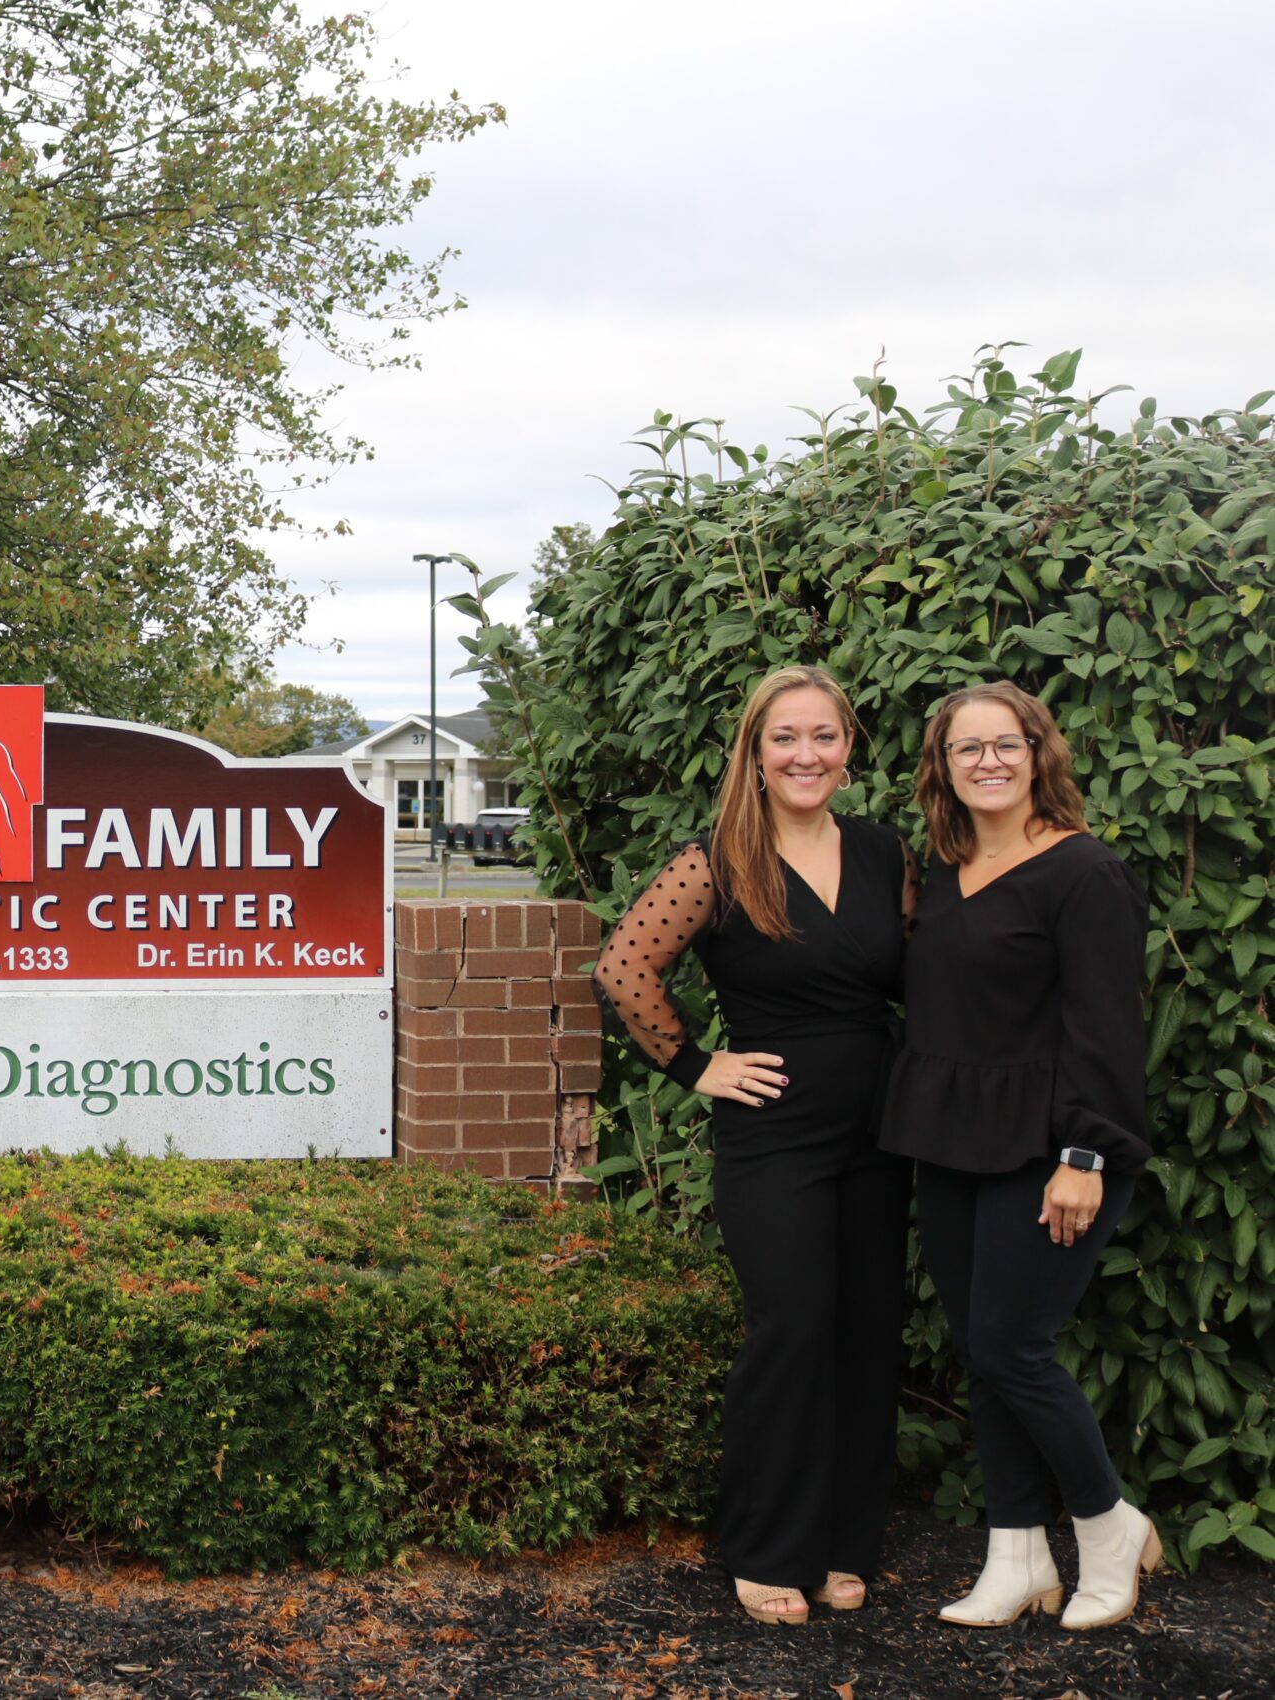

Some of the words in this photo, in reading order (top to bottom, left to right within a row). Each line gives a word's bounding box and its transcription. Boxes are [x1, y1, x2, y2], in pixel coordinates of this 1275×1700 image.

[412, 734, 427, 745] 37
[46, 807, 339, 868] FAMILY
[87, 893, 294, 930] CENTER
[137, 943, 176, 968] Dr.
[187, 942, 244, 967] Erin
[255, 942, 283, 967] K.
[293, 942, 366, 967] Keck
